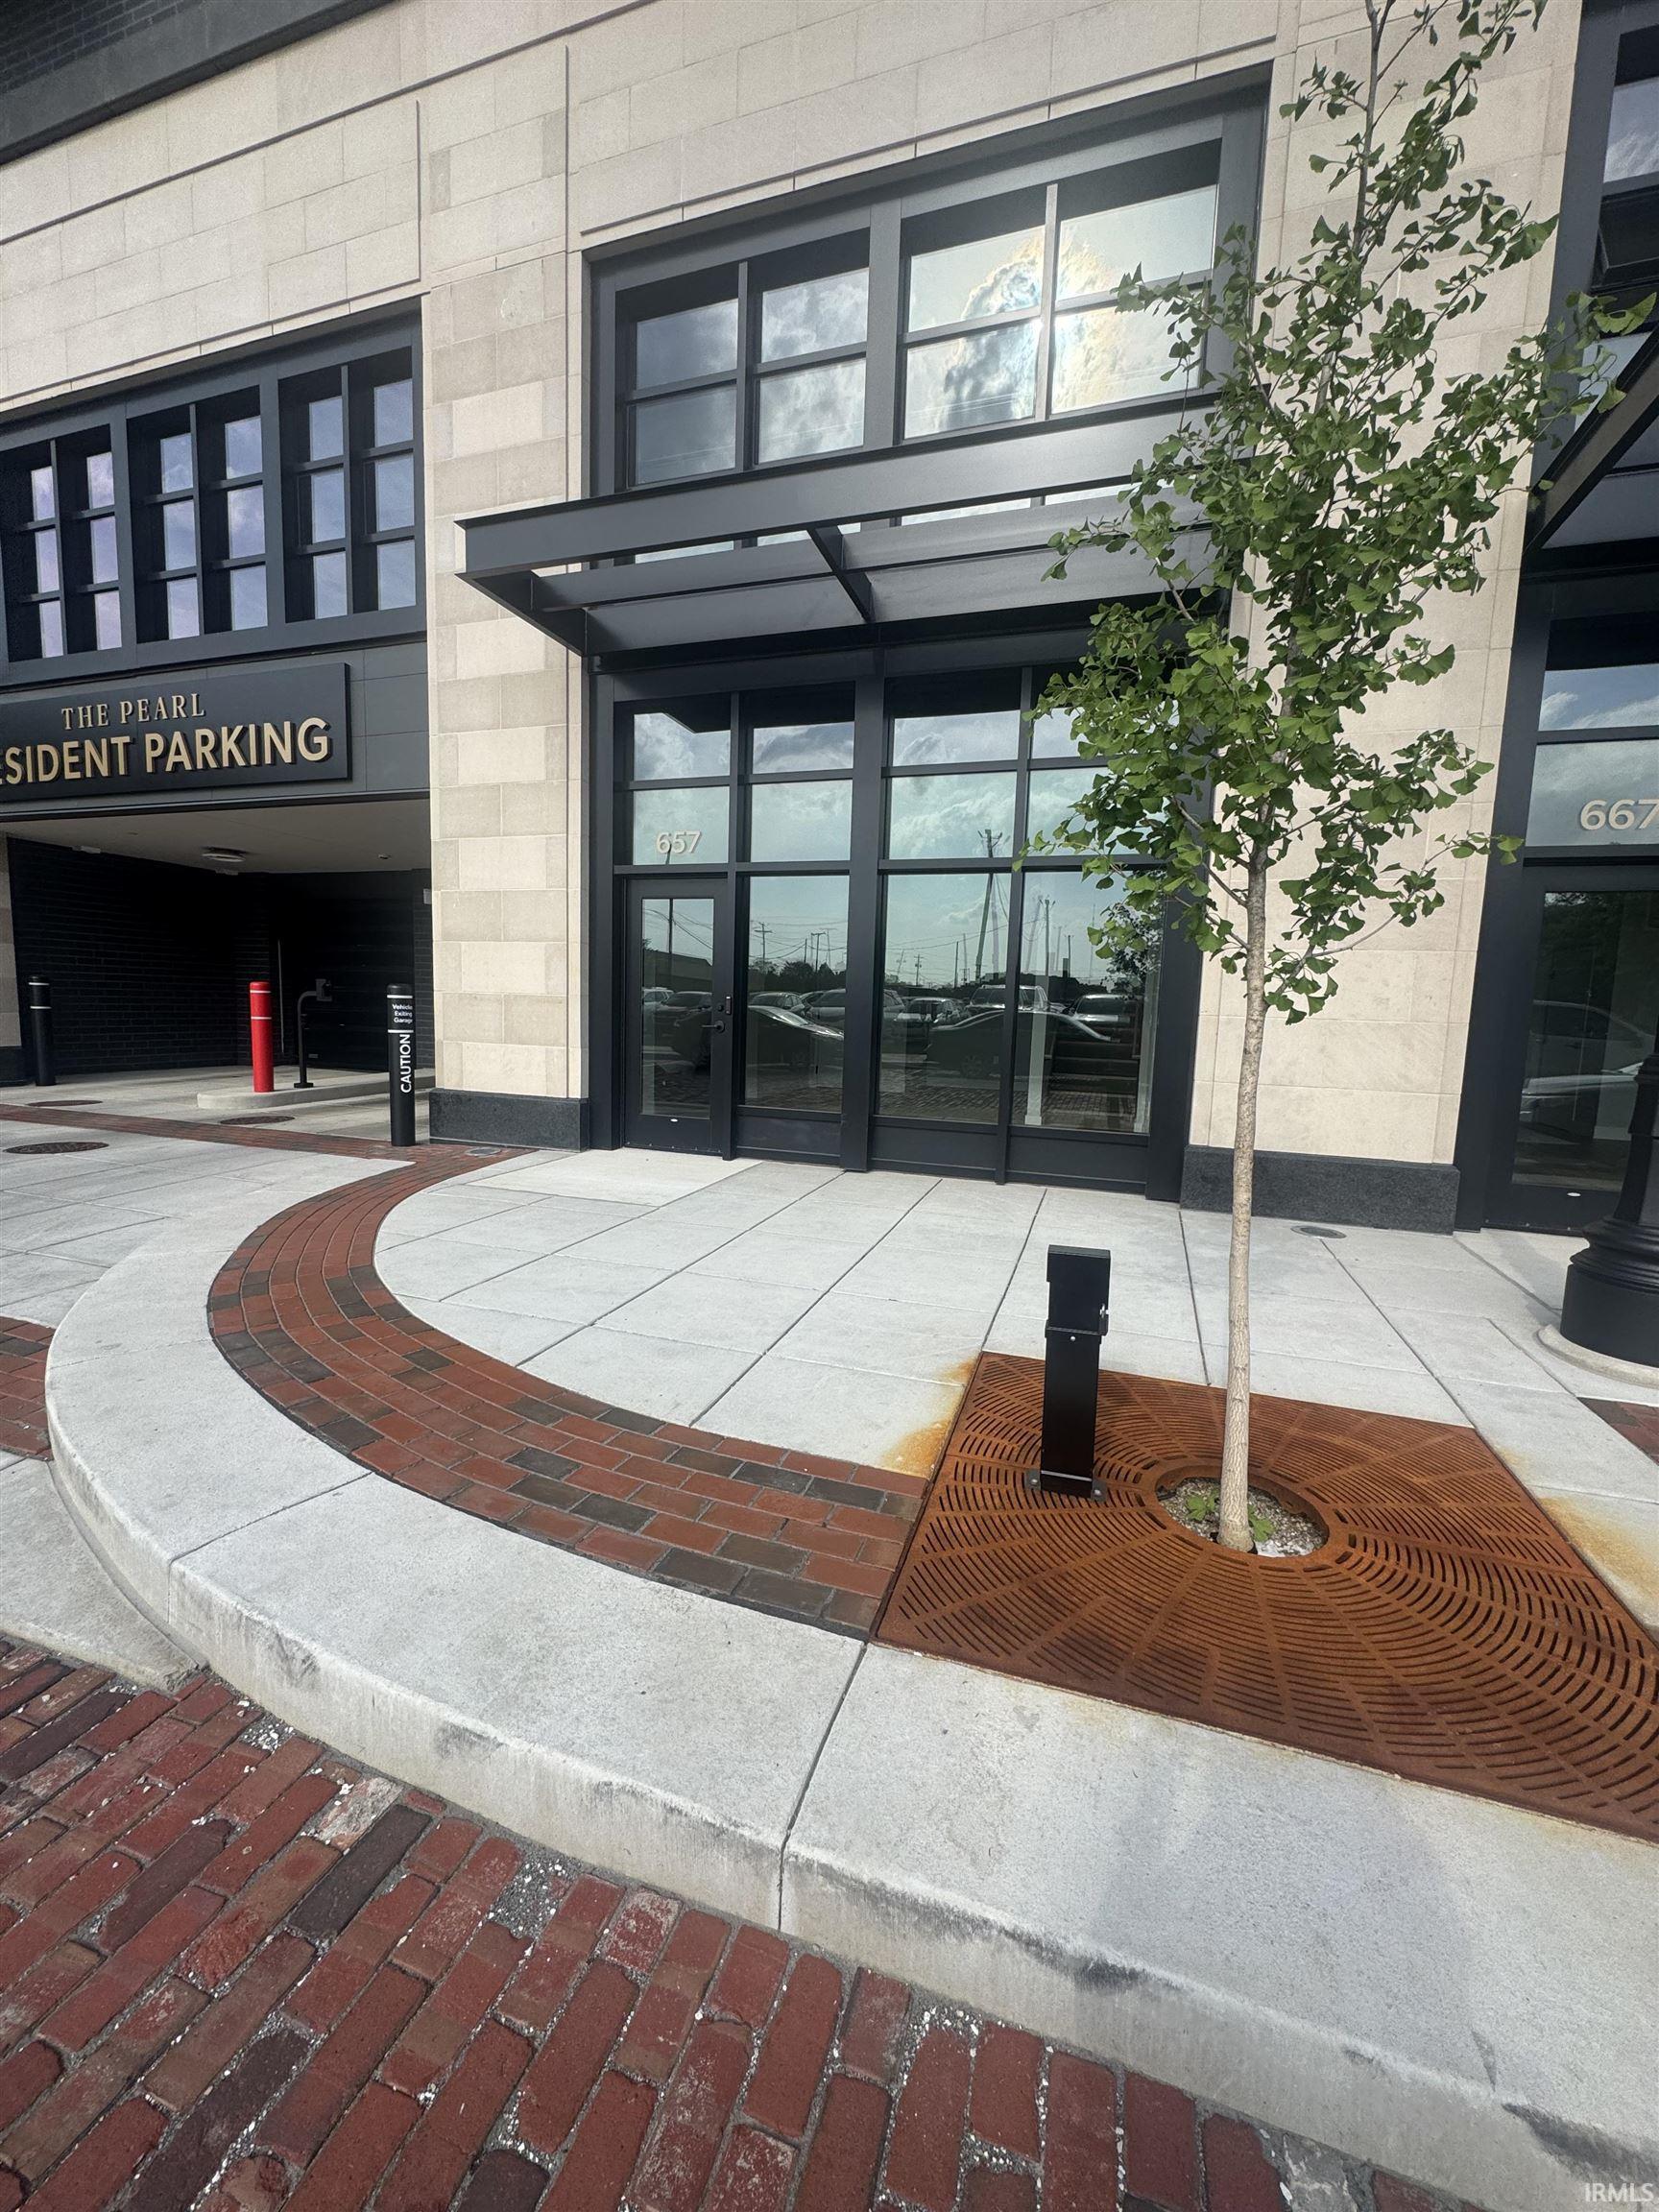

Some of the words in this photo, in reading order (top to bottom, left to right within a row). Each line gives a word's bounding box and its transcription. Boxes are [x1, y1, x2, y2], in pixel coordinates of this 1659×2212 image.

[60, 703, 109, 731] THE
[119, 692, 206, 725] PEARL
[0, 734, 132, 785] SIDENT
[145, 716, 332, 774] PARKING
[1579, 799, 1659, 830] 667
[656, 830, 702, 854] 657
[399, 1034, 412, 1094] CAUTION
